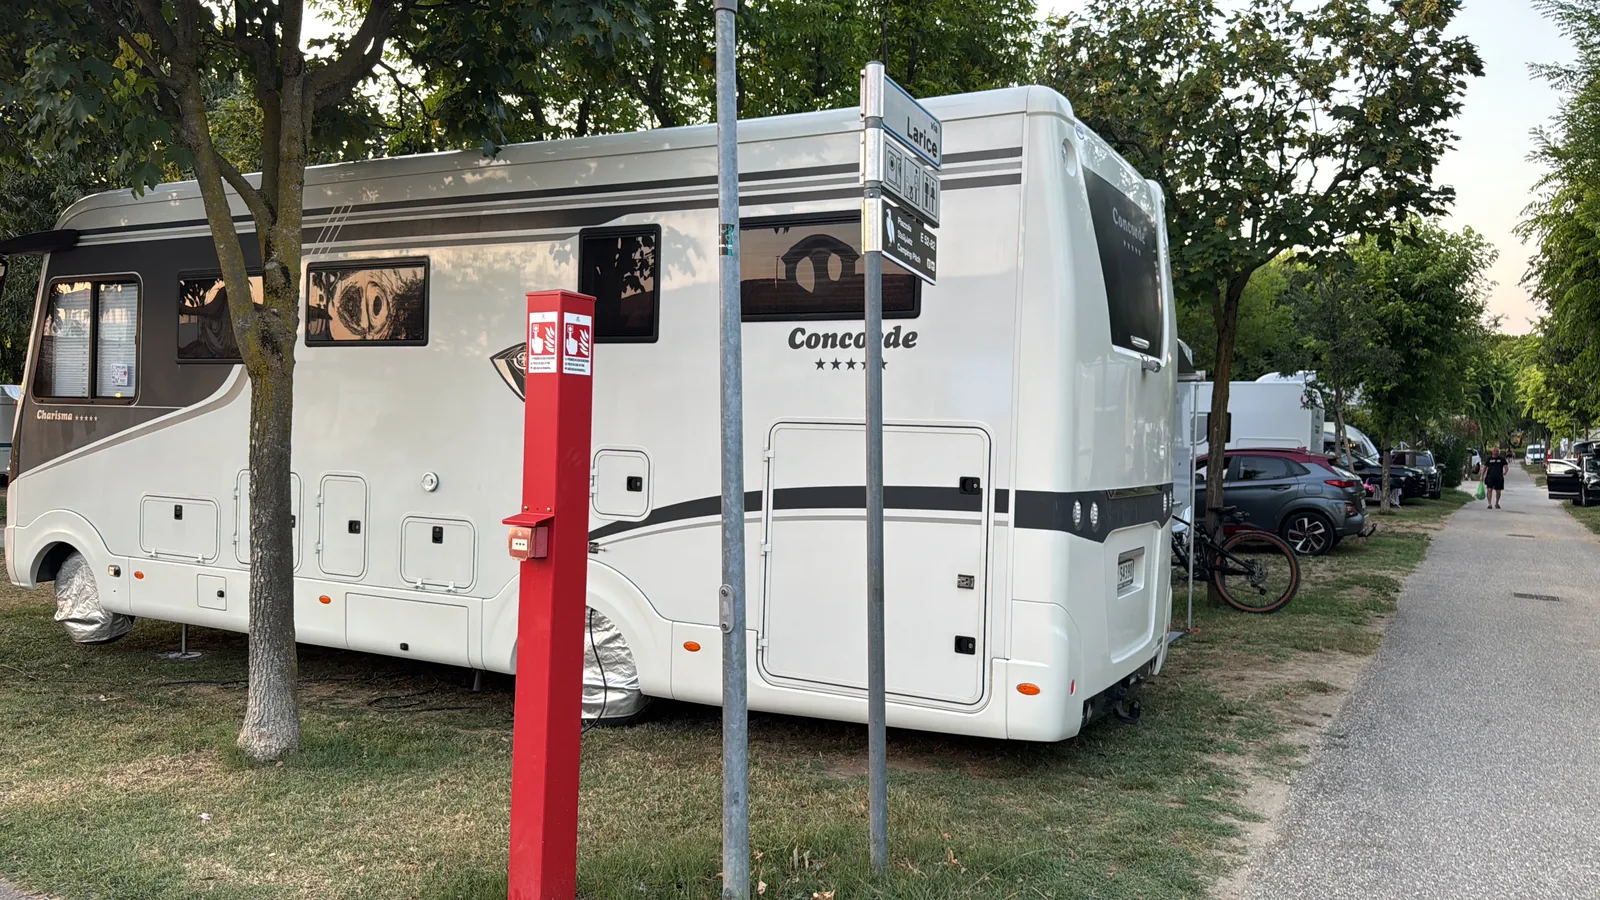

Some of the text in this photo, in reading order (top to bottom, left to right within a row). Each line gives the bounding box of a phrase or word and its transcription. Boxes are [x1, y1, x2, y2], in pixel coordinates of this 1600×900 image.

[906, 115, 938, 158] Larice
[1112, 206, 1146, 245] Concorde
[787, 325, 919, 350] Concode
[36, 409, 73, 421] Charisma
